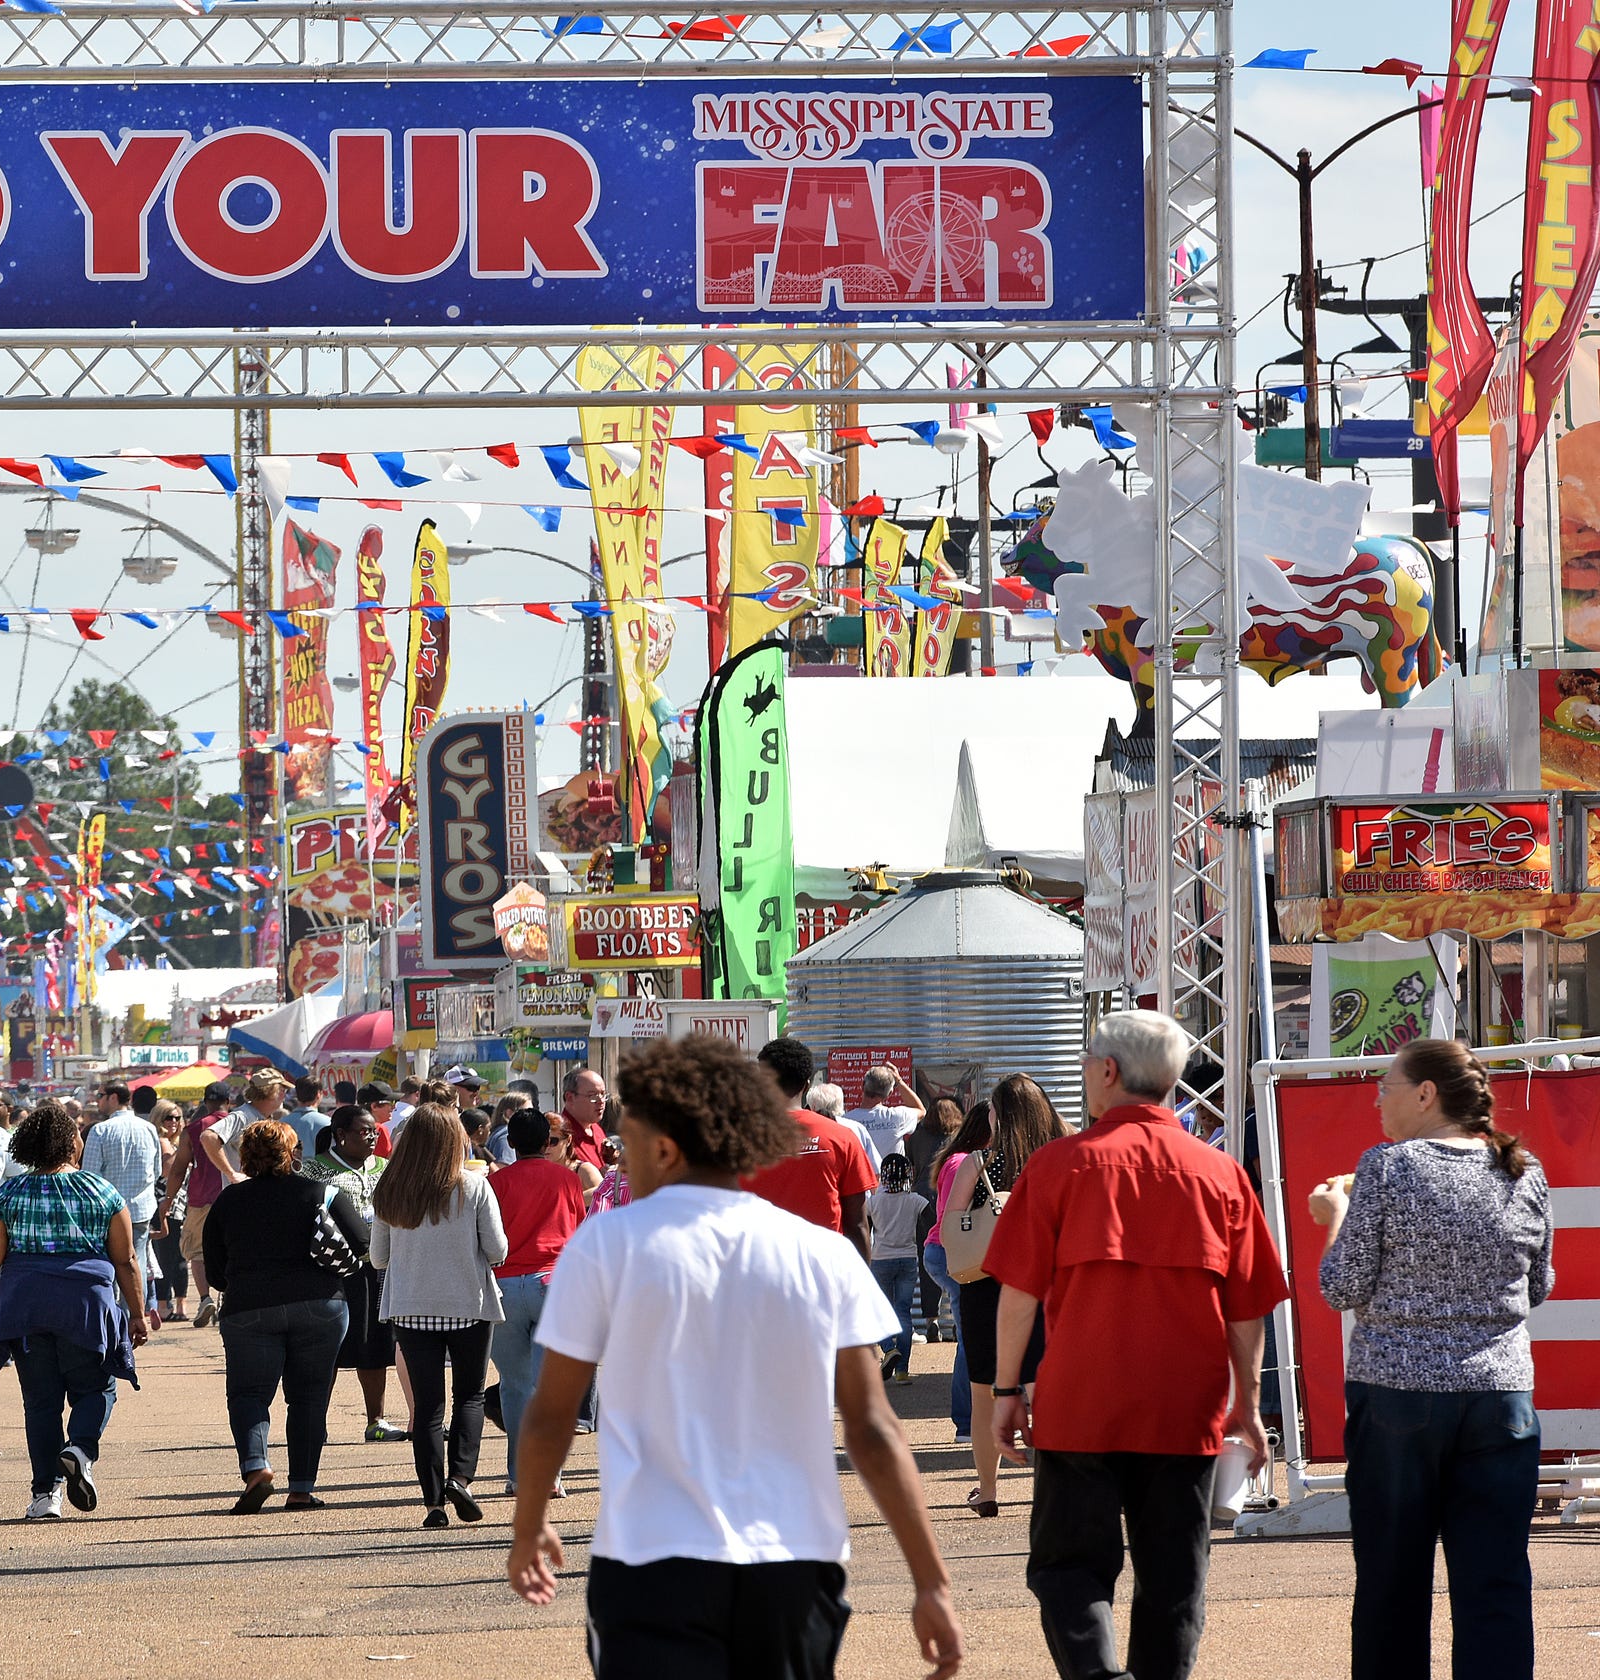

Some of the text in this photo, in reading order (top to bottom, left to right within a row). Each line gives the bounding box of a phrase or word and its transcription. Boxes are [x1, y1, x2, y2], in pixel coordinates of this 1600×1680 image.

[701, 98, 1046, 161] MISSISSIPPI STATE
[39, 125, 610, 284] YOUR
[695, 160, 1053, 312] FAIR
[1406, 438, 1424, 451] 29
[1026, 600, 1043, 609] 35
[290, 651, 316, 683] HOT
[287, 695, 323, 730] PIZZA
[441, 733, 501, 949] GYROS
[1352, 816, 1538, 868] FRIES
[1342, 868, 1550, 891] CHILI CHEESE BACON RANCH
[497, 908, 520, 931] BAKED
[578, 904, 696, 931] ROOTBEER
[596, 931, 682, 957] FLOATS
[545, 973, 582, 986] FRESH
[518, 986, 592, 1003] LEMONADE
[522, 1004, 588, 1016] SHAKE-UPS
[156, 1047, 189, 1063] Drinks
[542, 1040, 587, 1052] BREWED
[870, 1051, 887, 1059] BEEF
[890, 1050, 909, 1059] BARN
